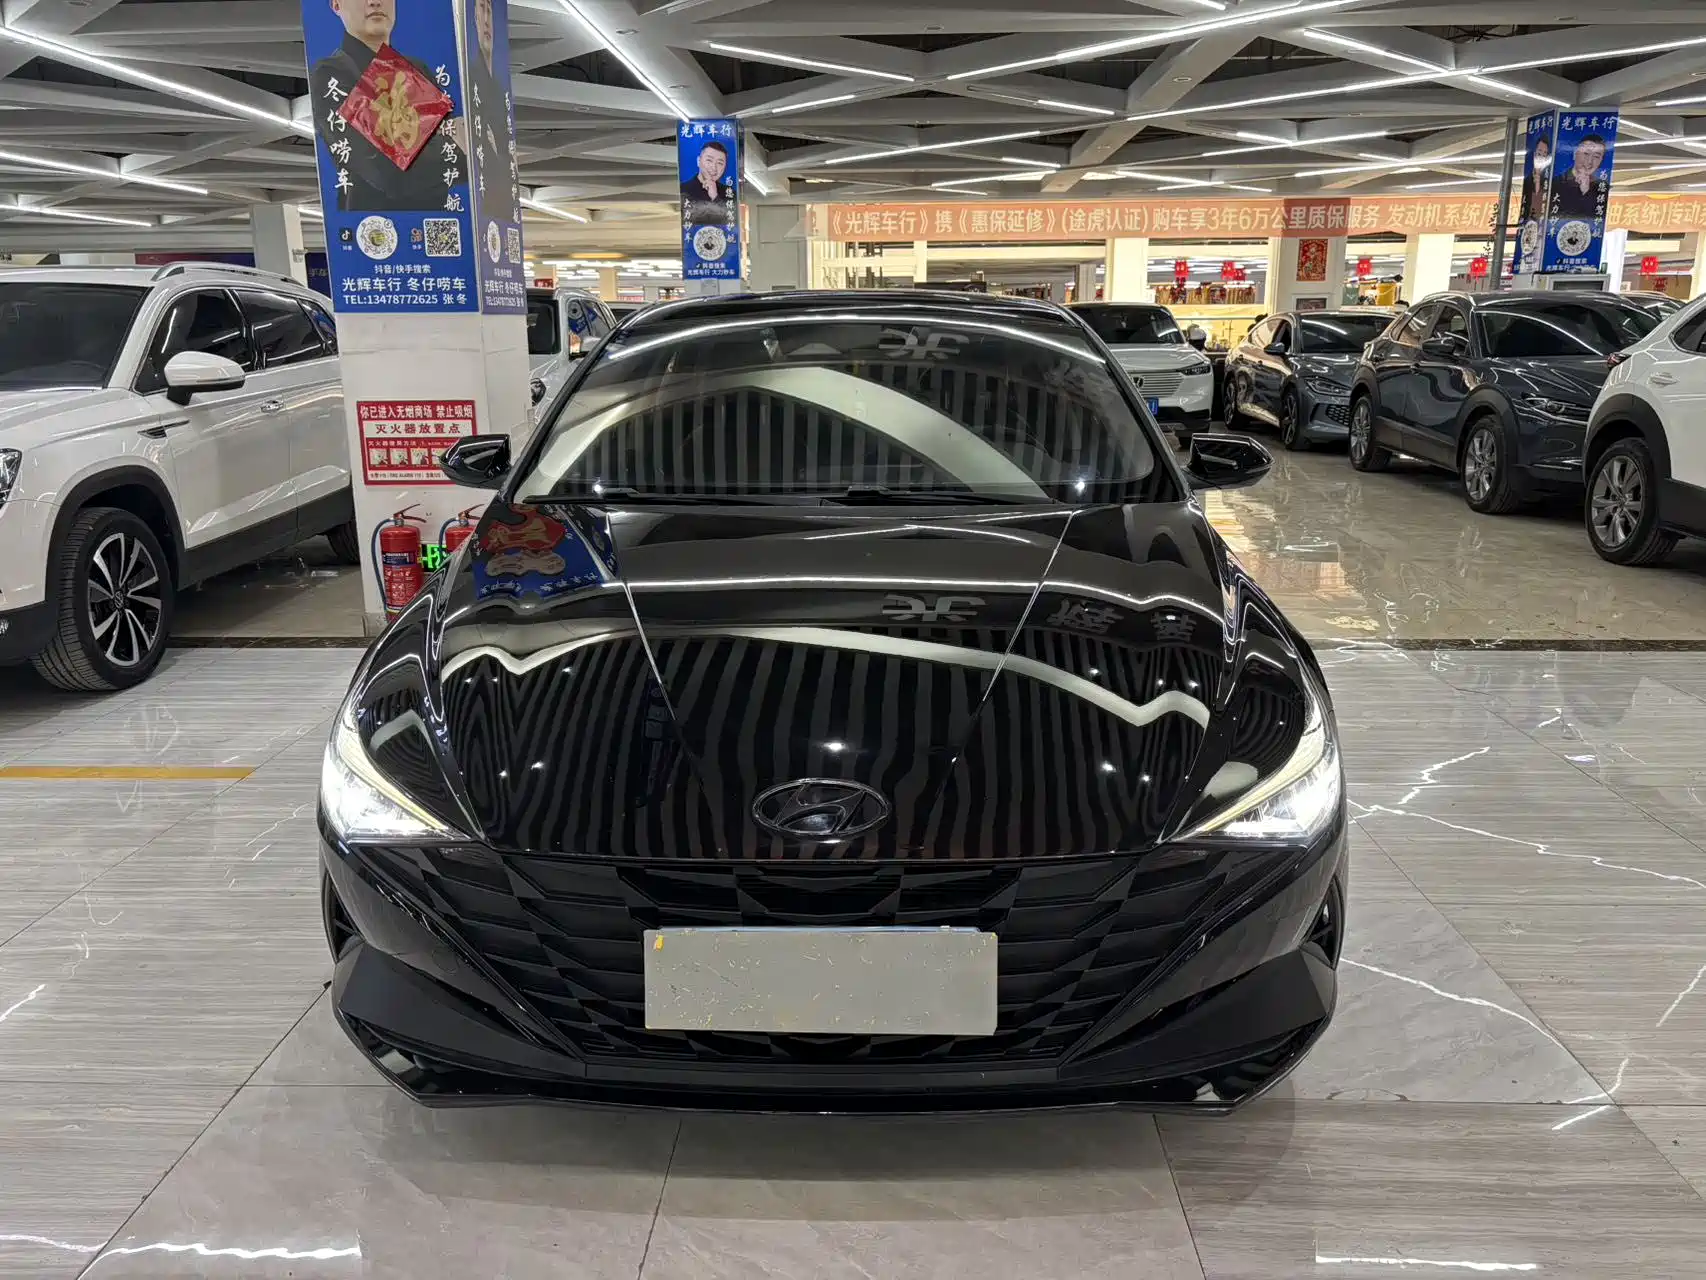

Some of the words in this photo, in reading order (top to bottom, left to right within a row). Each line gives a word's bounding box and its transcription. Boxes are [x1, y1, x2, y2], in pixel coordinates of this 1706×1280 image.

[435, 64, 464, 212] 为保驾护航
[342, 277, 401, 292] 光辉车行
[407, 277, 467, 292] 冬仔唠车
[344, 295, 438, 305] TEL:13478772625
[436, 405, 473, 418] 禁止吸烟
[375, 423, 461, 434] 灭火器放置点
